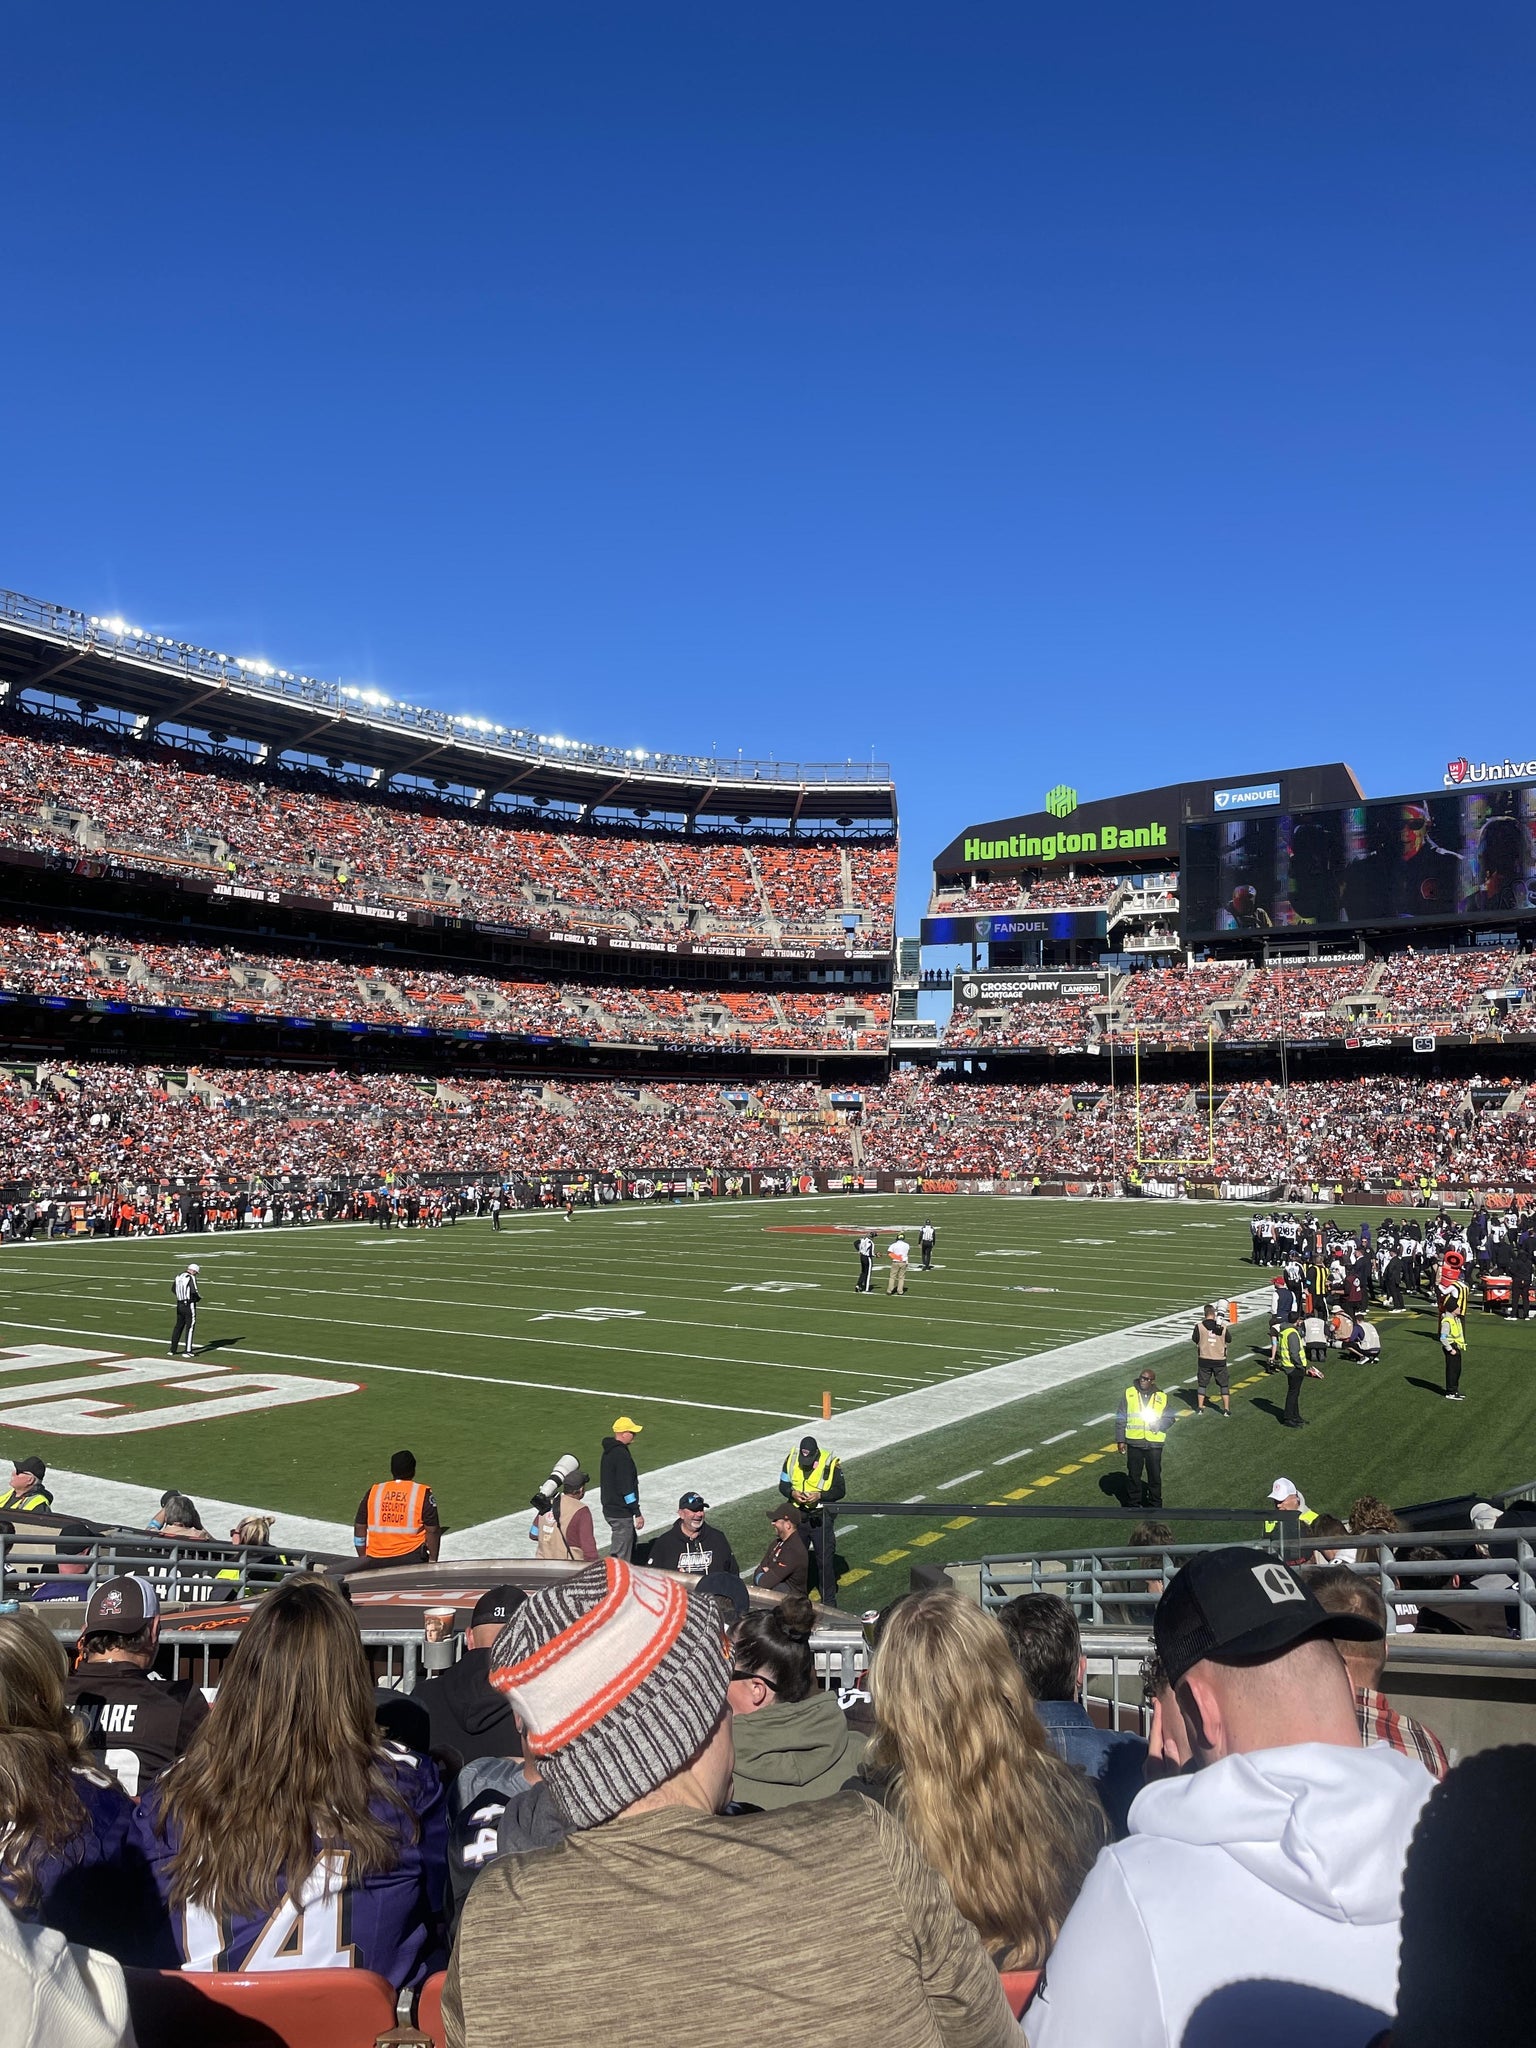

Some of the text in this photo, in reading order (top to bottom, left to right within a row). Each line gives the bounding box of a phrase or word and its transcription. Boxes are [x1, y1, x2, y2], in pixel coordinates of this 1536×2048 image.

[1231, 789, 1280, 803] FANDUEL
[964, 822, 1167, 862] Huntington Bank
[213, 884, 280, 904] JIM BROWN 32
[332, 902, 408, 922] PAUL WARFIELD 42
[994, 921, 1048, 933] FANDUEL
[549, 932, 563, 941] LOU
[587, 937, 598, 946] 76
[609, 939, 630, 948] OZZIE
[630, 940, 665, 951] NEWSOME
[692, 945, 707, 954] MAC
[708, 946, 735, 956] SPEEDIE
[761, 949, 816, 959] JOE THOMAS 73
[1283, 956, 1306, 964] ISSUES
[1308, 955, 1318, 963] TO
[1319, 953, 1364, 963] 440-824-6000
[980, 981, 1098, 993] CROSSCOUNTRY LANDING
[981, 991, 1023, 999] MORTGAGE
[1260, 1223, 1270, 1233] 87
[1285, 1227, 1295, 1237] 85
[1406, 1244, 1412, 1255] 6
[384, 1491, 407, 1502] APEX
[381, 1502, 407, 1513] SECURITY
[381, 1513, 405, 1523] GROUP
[493, 1606, 506, 1617] 31
